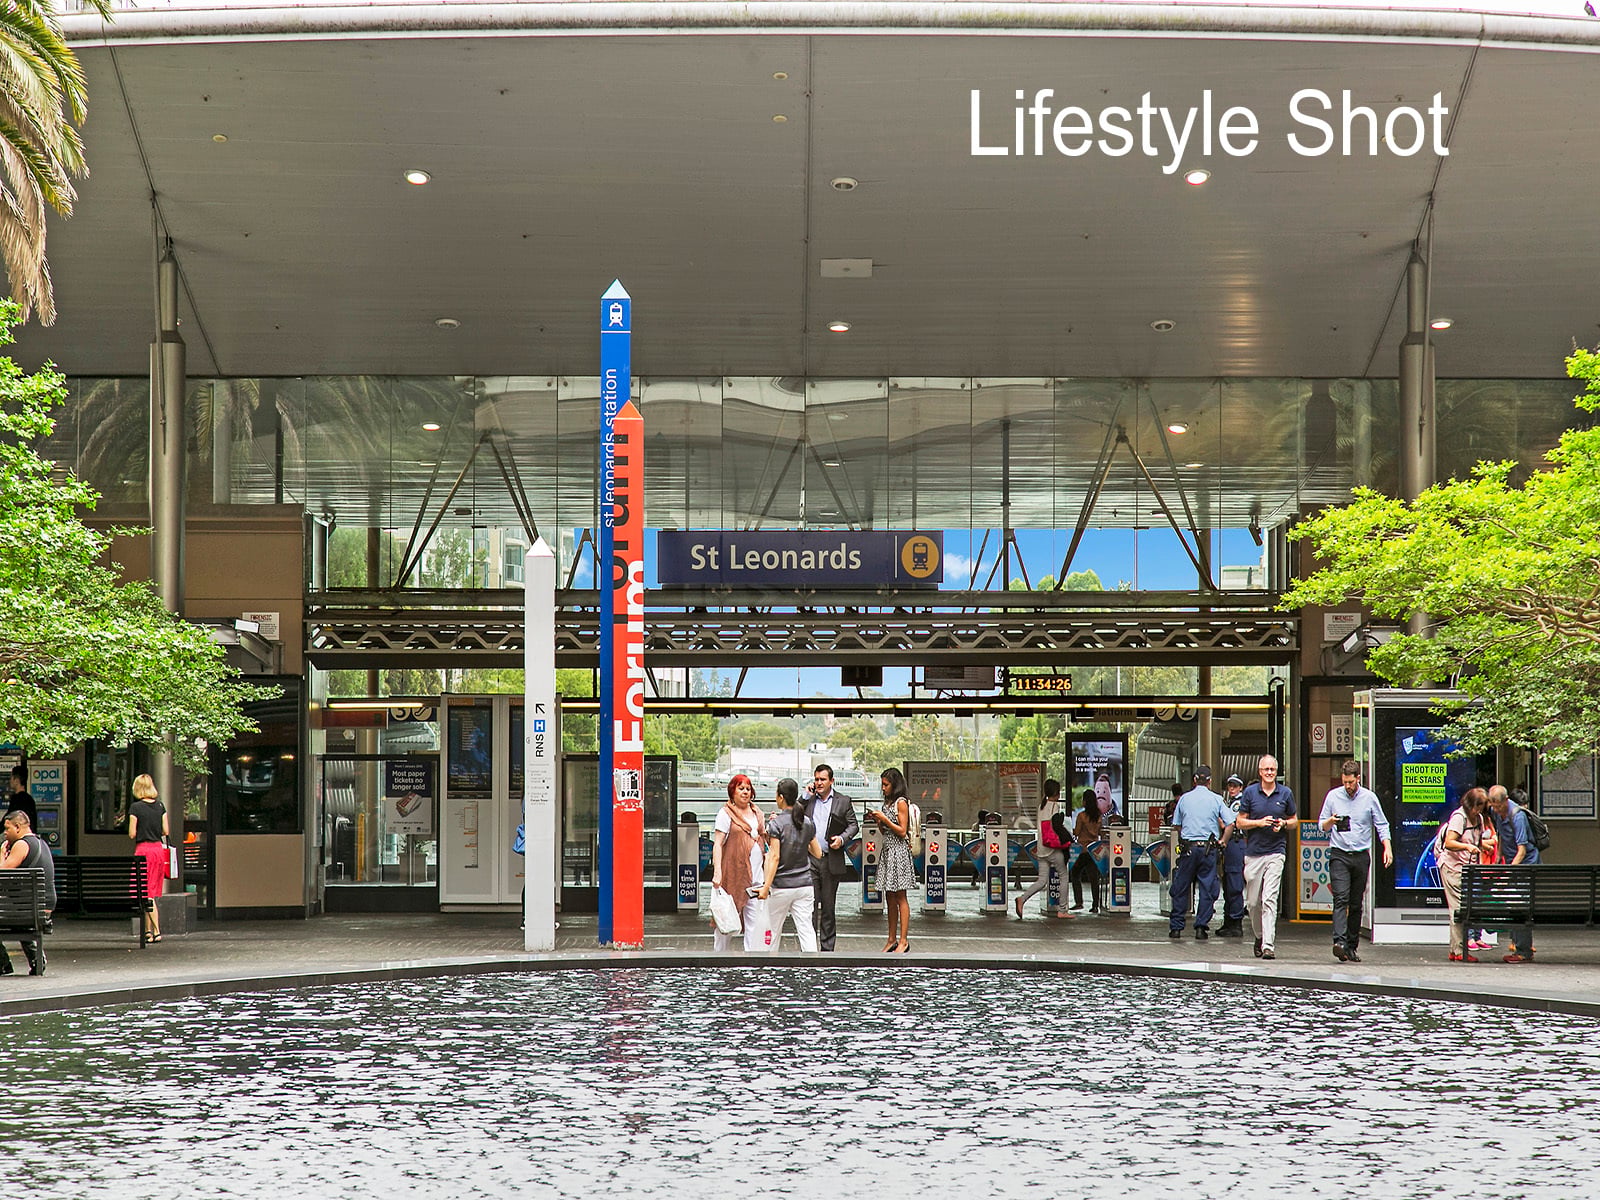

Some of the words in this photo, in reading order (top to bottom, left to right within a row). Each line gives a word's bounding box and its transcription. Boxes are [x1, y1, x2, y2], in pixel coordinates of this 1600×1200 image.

[602, 368, 617, 426] station
[602, 432, 615, 508] leonards
[605, 511, 615, 528] st
[690, 544, 720, 570] St
[730, 542, 862, 570] Leonards
[1016, 678, 1072, 690] 11:34:26
[535, 733, 544, 757] RNS
[33, 768, 59, 781] opal
[1404, 765, 1429, 774] SHOOT
[1430, 765, 1445, 774] FOR
[1404, 775, 1419, 784] THE
[1419, 775, 1442, 784] STARS
[1302, 831, 1316, 839] right
[686, 882, 696, 890] get
[927, 889, 943, 897] Opal
